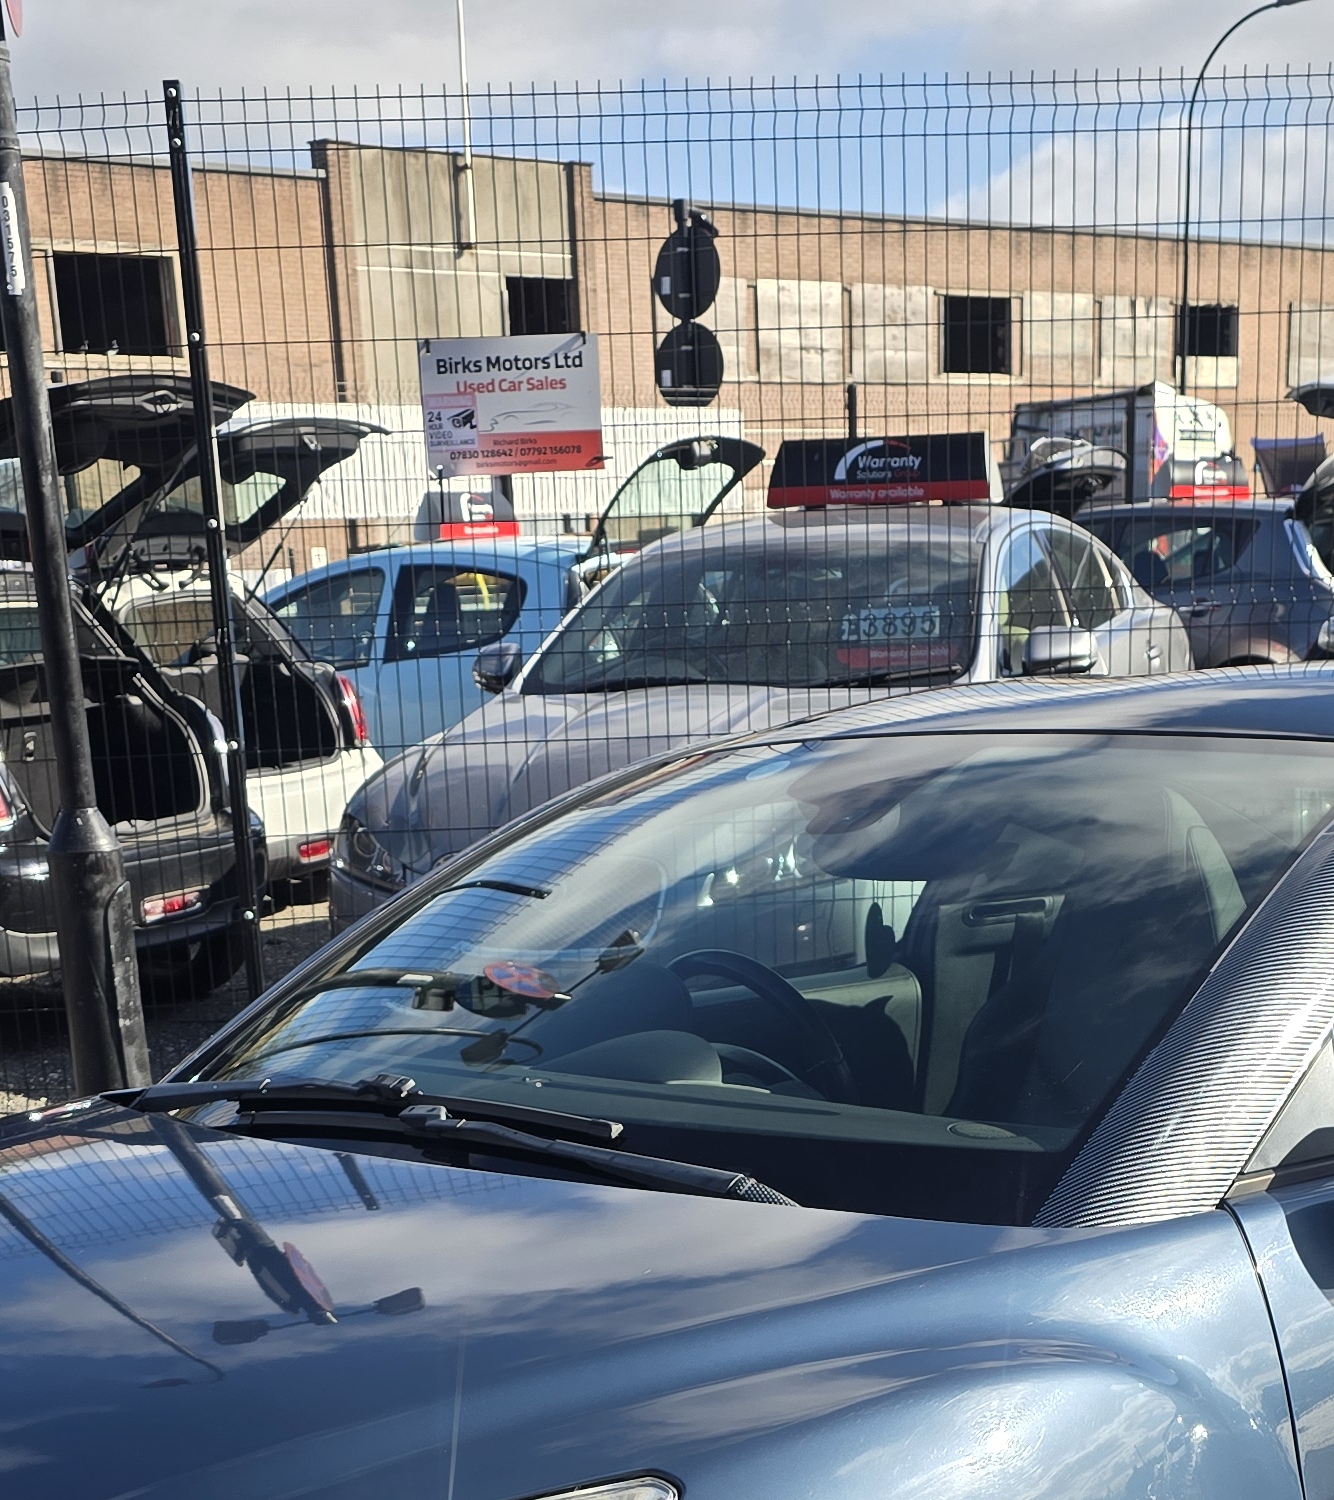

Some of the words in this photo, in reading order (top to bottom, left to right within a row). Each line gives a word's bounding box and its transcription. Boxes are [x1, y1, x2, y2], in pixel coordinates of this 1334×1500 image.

[2, 196, 17, 277] 031575
[436, 356, 482, 374] Birks
[486, 354, 551, 372] Motors
[554, 351, 583, 368] Ltd
[456, 378, 495, 393] Used
[499, 378, 523, 392] Car
[526, 376, 567, 391] Sales
[427, 411, 442, 422] 24
[429, 431, 453, 439] VIDEO
[857, 454, 923, 471] Warranty
[829, 487, 877, 501] Warranty
